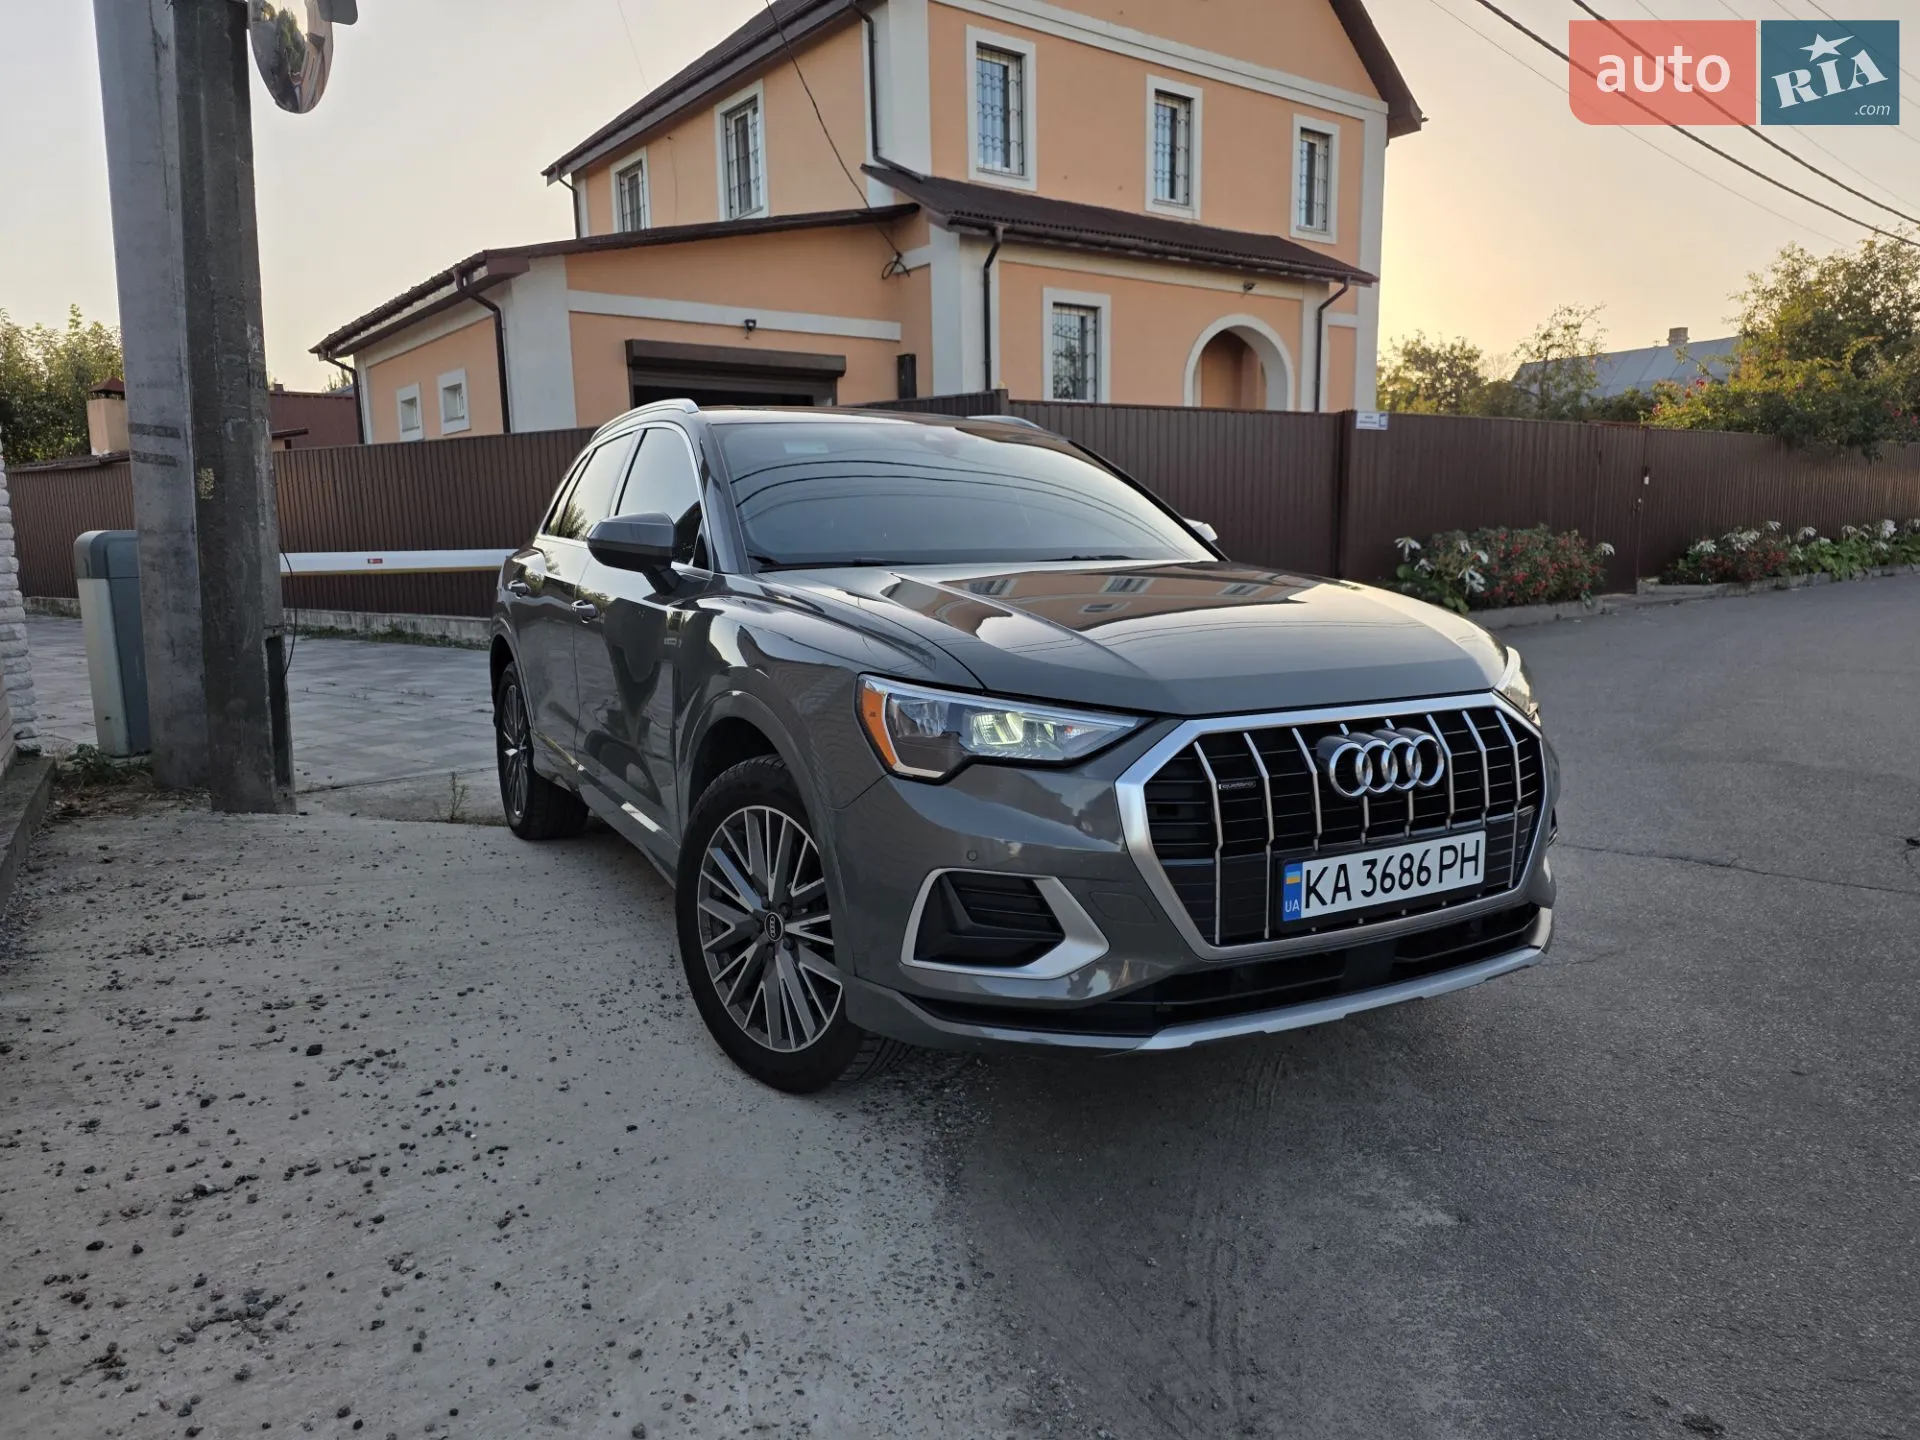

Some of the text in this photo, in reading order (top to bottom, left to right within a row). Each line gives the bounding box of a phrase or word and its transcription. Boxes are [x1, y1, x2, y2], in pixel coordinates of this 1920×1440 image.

[1304, 839, 1481, 909] KA 3686 PH
[1284, 898, 1300, 913] UA
